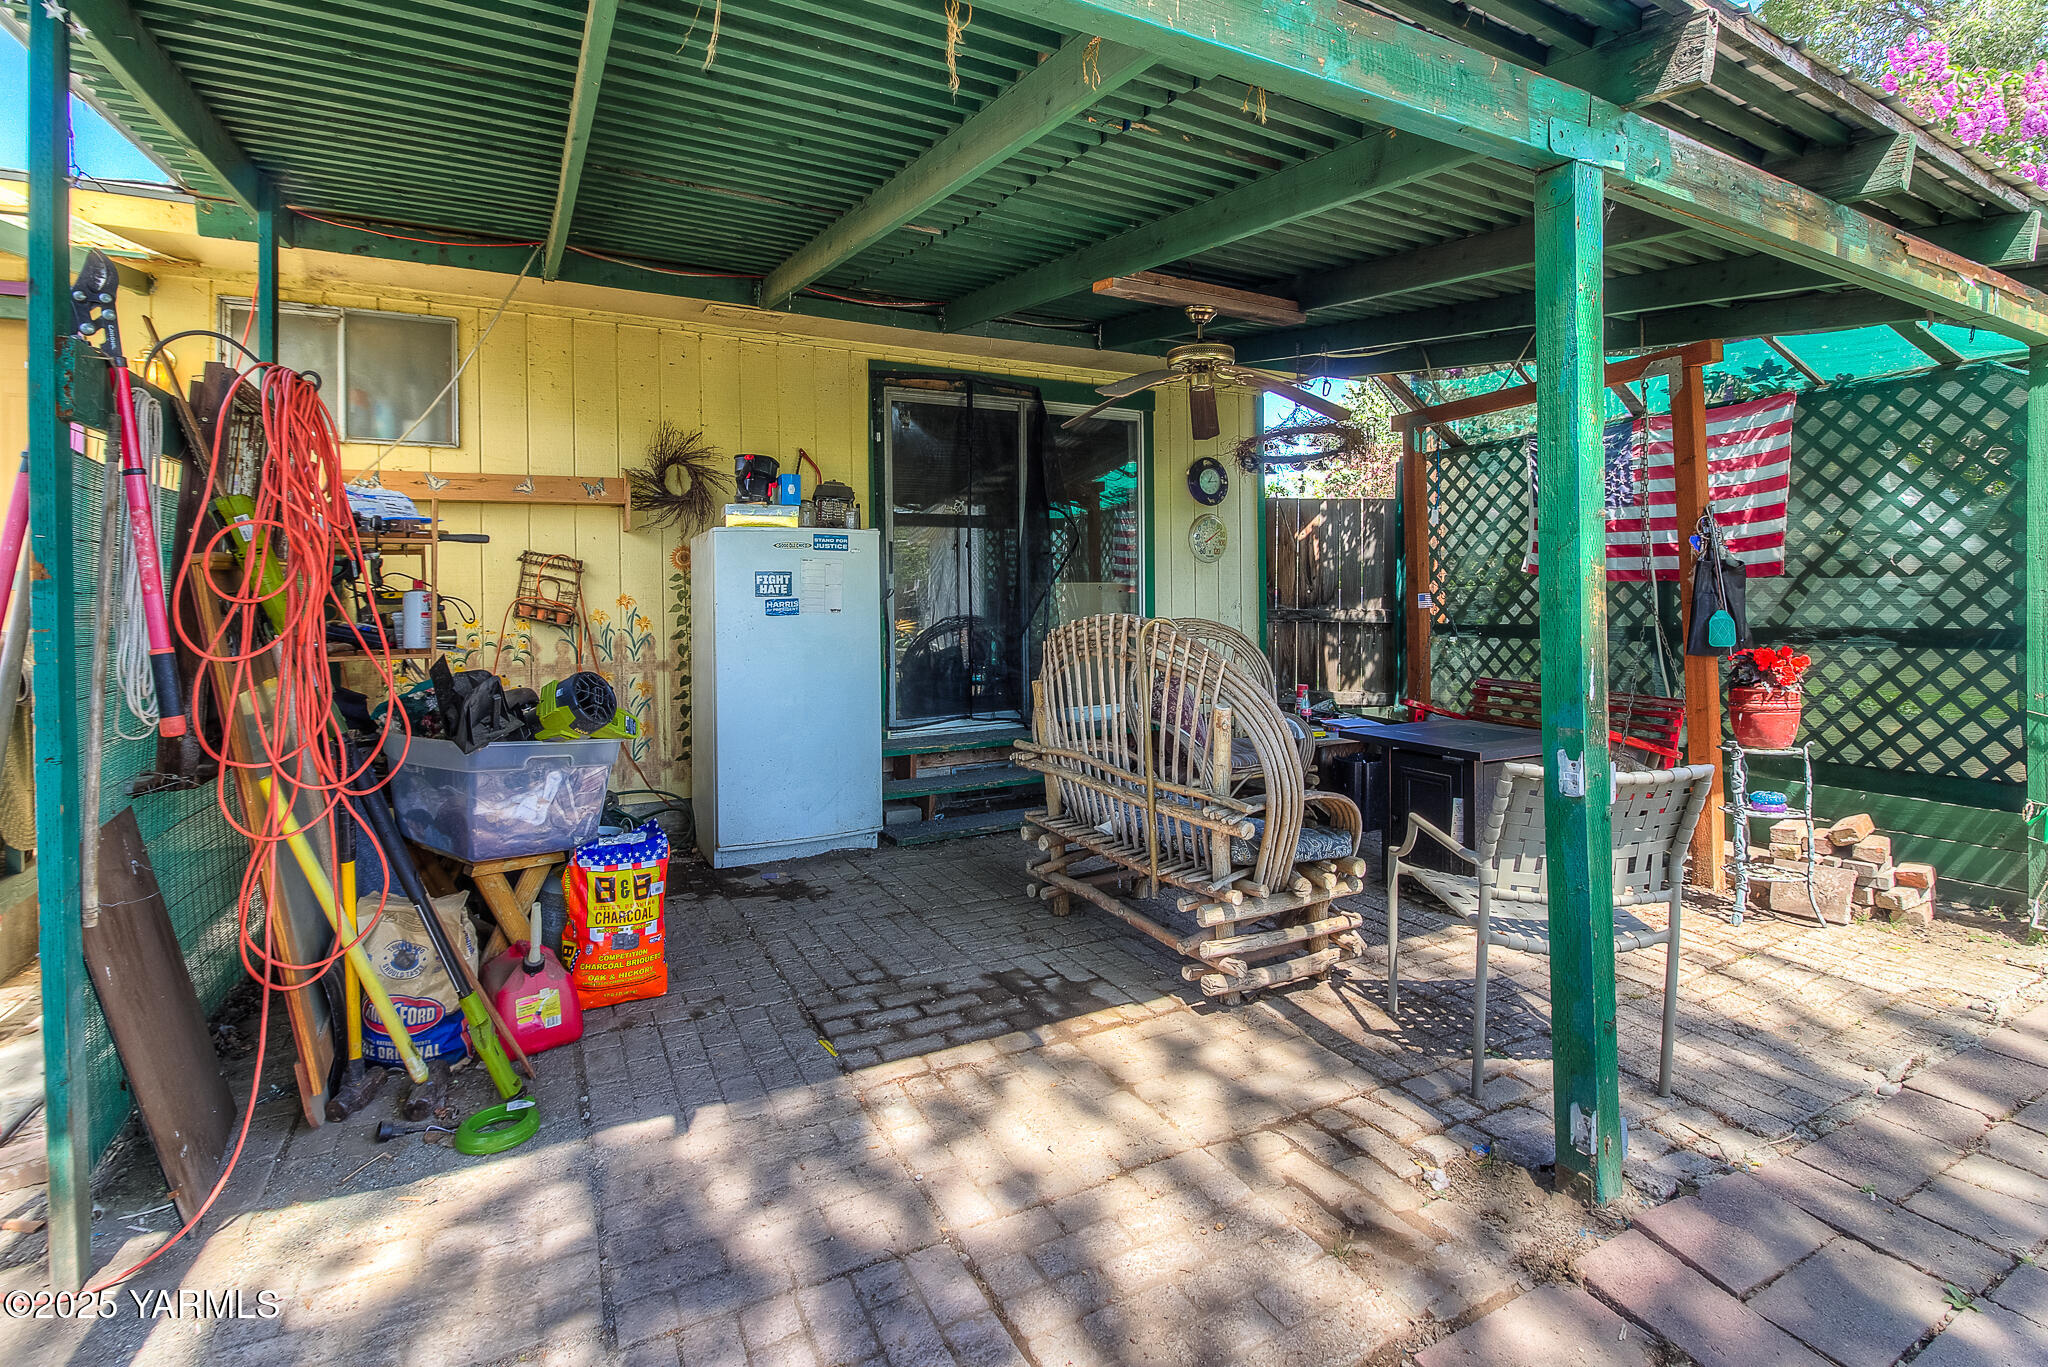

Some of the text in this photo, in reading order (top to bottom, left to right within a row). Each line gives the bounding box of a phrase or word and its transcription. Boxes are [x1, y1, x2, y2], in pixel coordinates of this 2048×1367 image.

[756, 574, 791, 585] FIGHT
[760, 584, 788, 594] HATE
[766, 600, 799, 608] HARRIS
[595, 906, 654, 925] CHARCOAL
[580, 951, 661, 971] CHARCOAL BRIQUETS
[598, 948, 648, 962] COMPETITION
[587, 974, 607, 982] OAK
[618, 965, 654, 979] HICKORY
